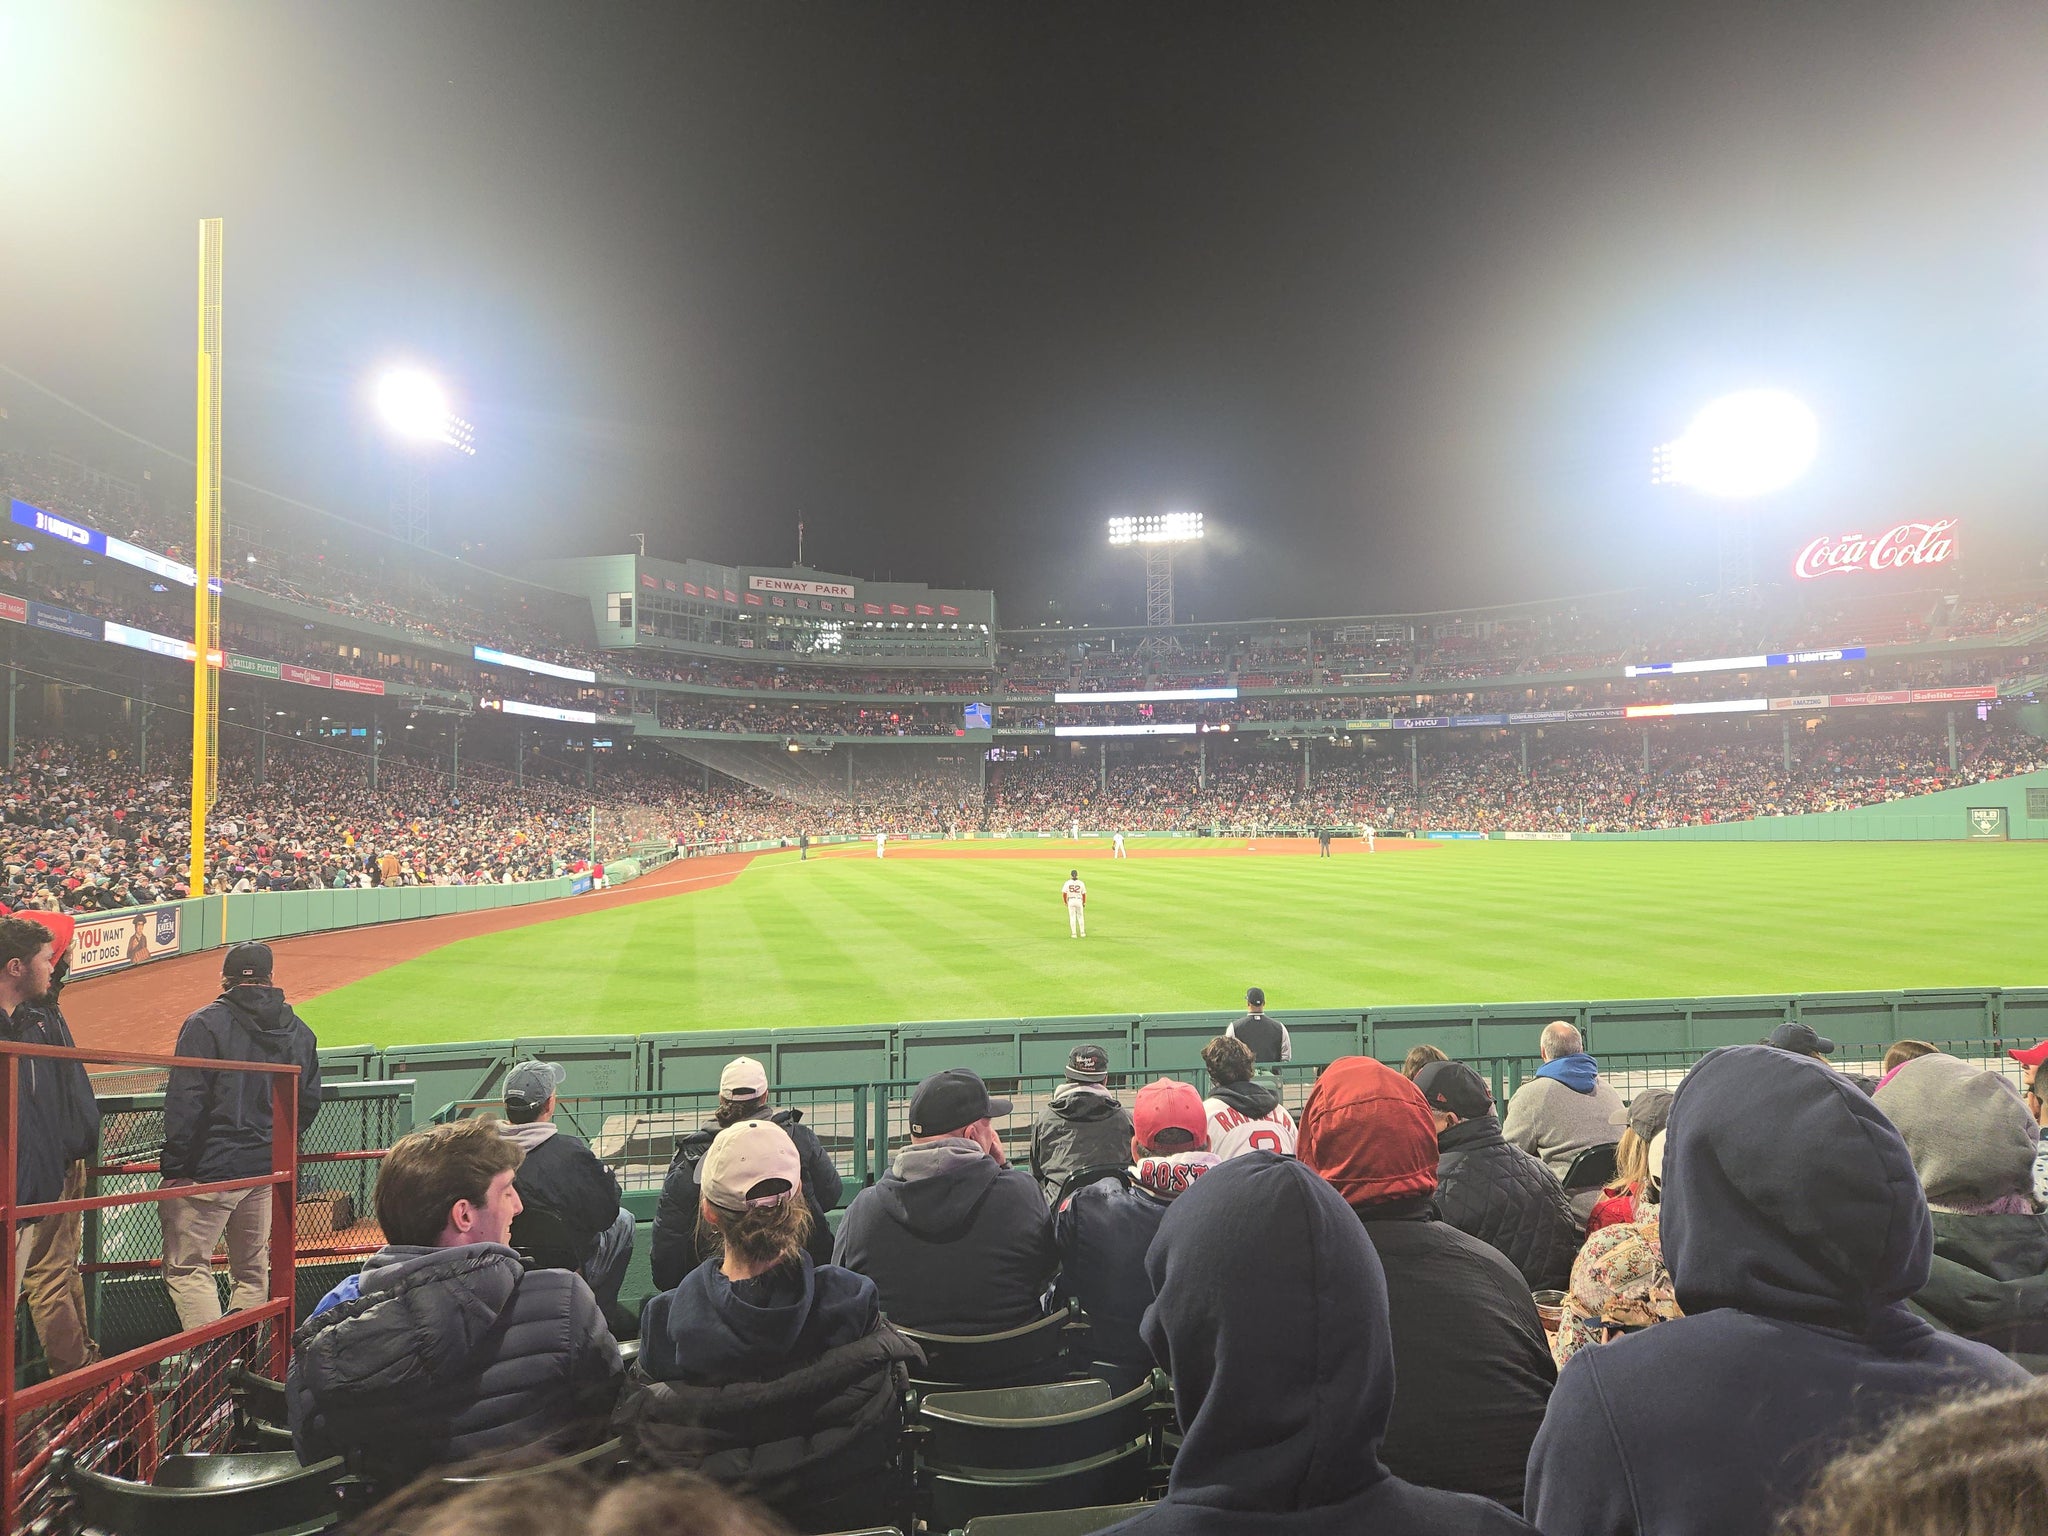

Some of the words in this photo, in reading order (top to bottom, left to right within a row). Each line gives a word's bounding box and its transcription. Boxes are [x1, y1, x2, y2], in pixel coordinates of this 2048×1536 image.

[1795, 518, 1958, 578] Coca-Cola
[756, 579, 808, 592] FENWAY
[815, 585, 848, 596] PARK
[1914, 692, 1953, 700] Safelite
[1414, 719, 1438, 727] HYCU
[1973, 810, 1997, 818] MLB
[1068, 884, 1081, 894] 52
[77, 928, 102, 950] YOU
[103, 927, 124, 942] WANT
[80, 949, 98, 964] HOT
[99, 945, 120, 961] DOGS
[1214, 1106, 1292, 1133] RAELA
